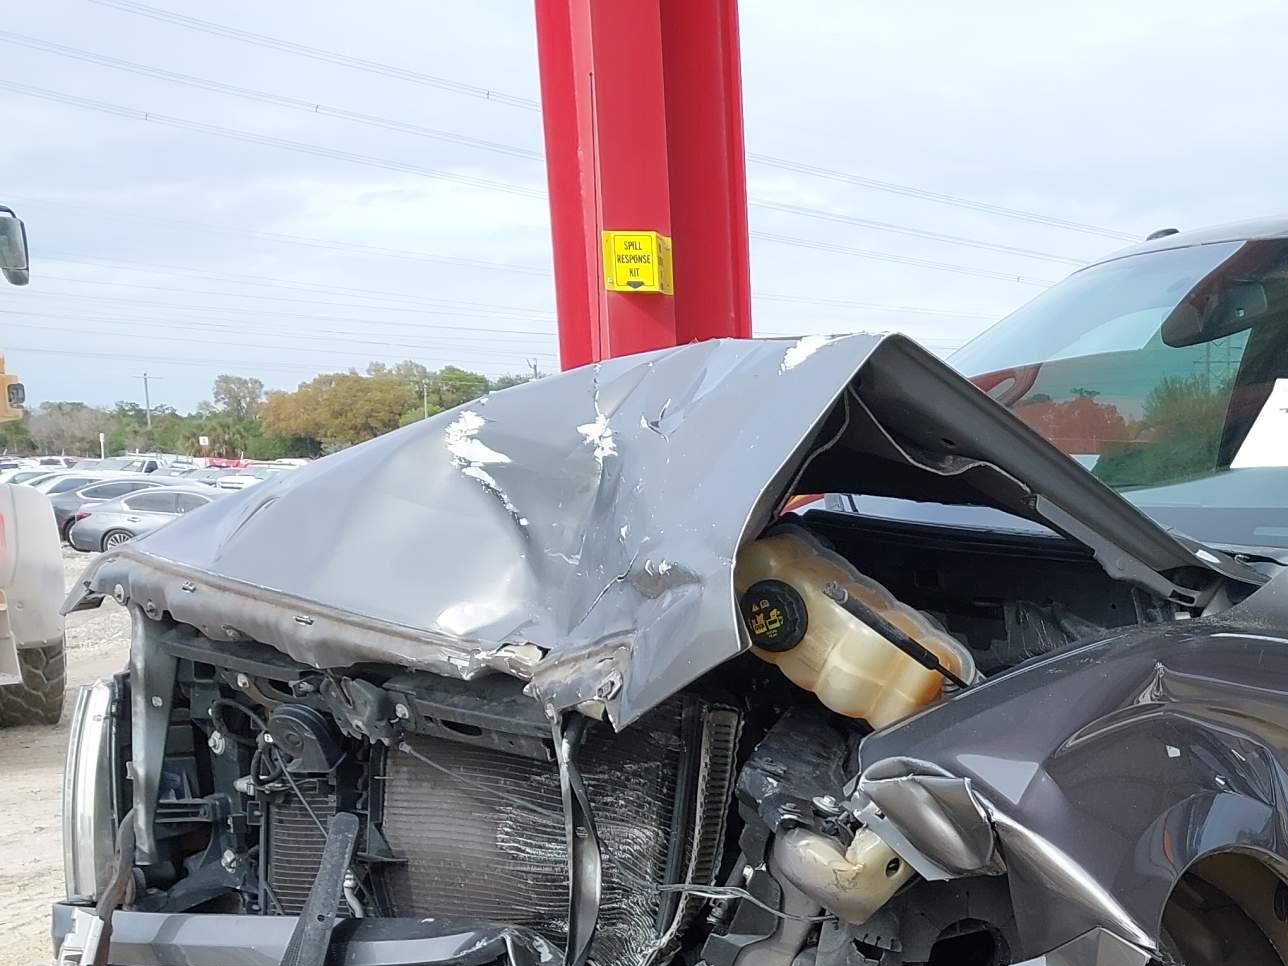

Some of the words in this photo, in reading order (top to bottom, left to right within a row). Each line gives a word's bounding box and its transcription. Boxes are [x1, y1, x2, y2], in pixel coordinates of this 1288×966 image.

[623, 240, 643, 251] SPILL
[616, 254, 651, 264] RESPONSE
[628, 267, 640, 278] KIT
